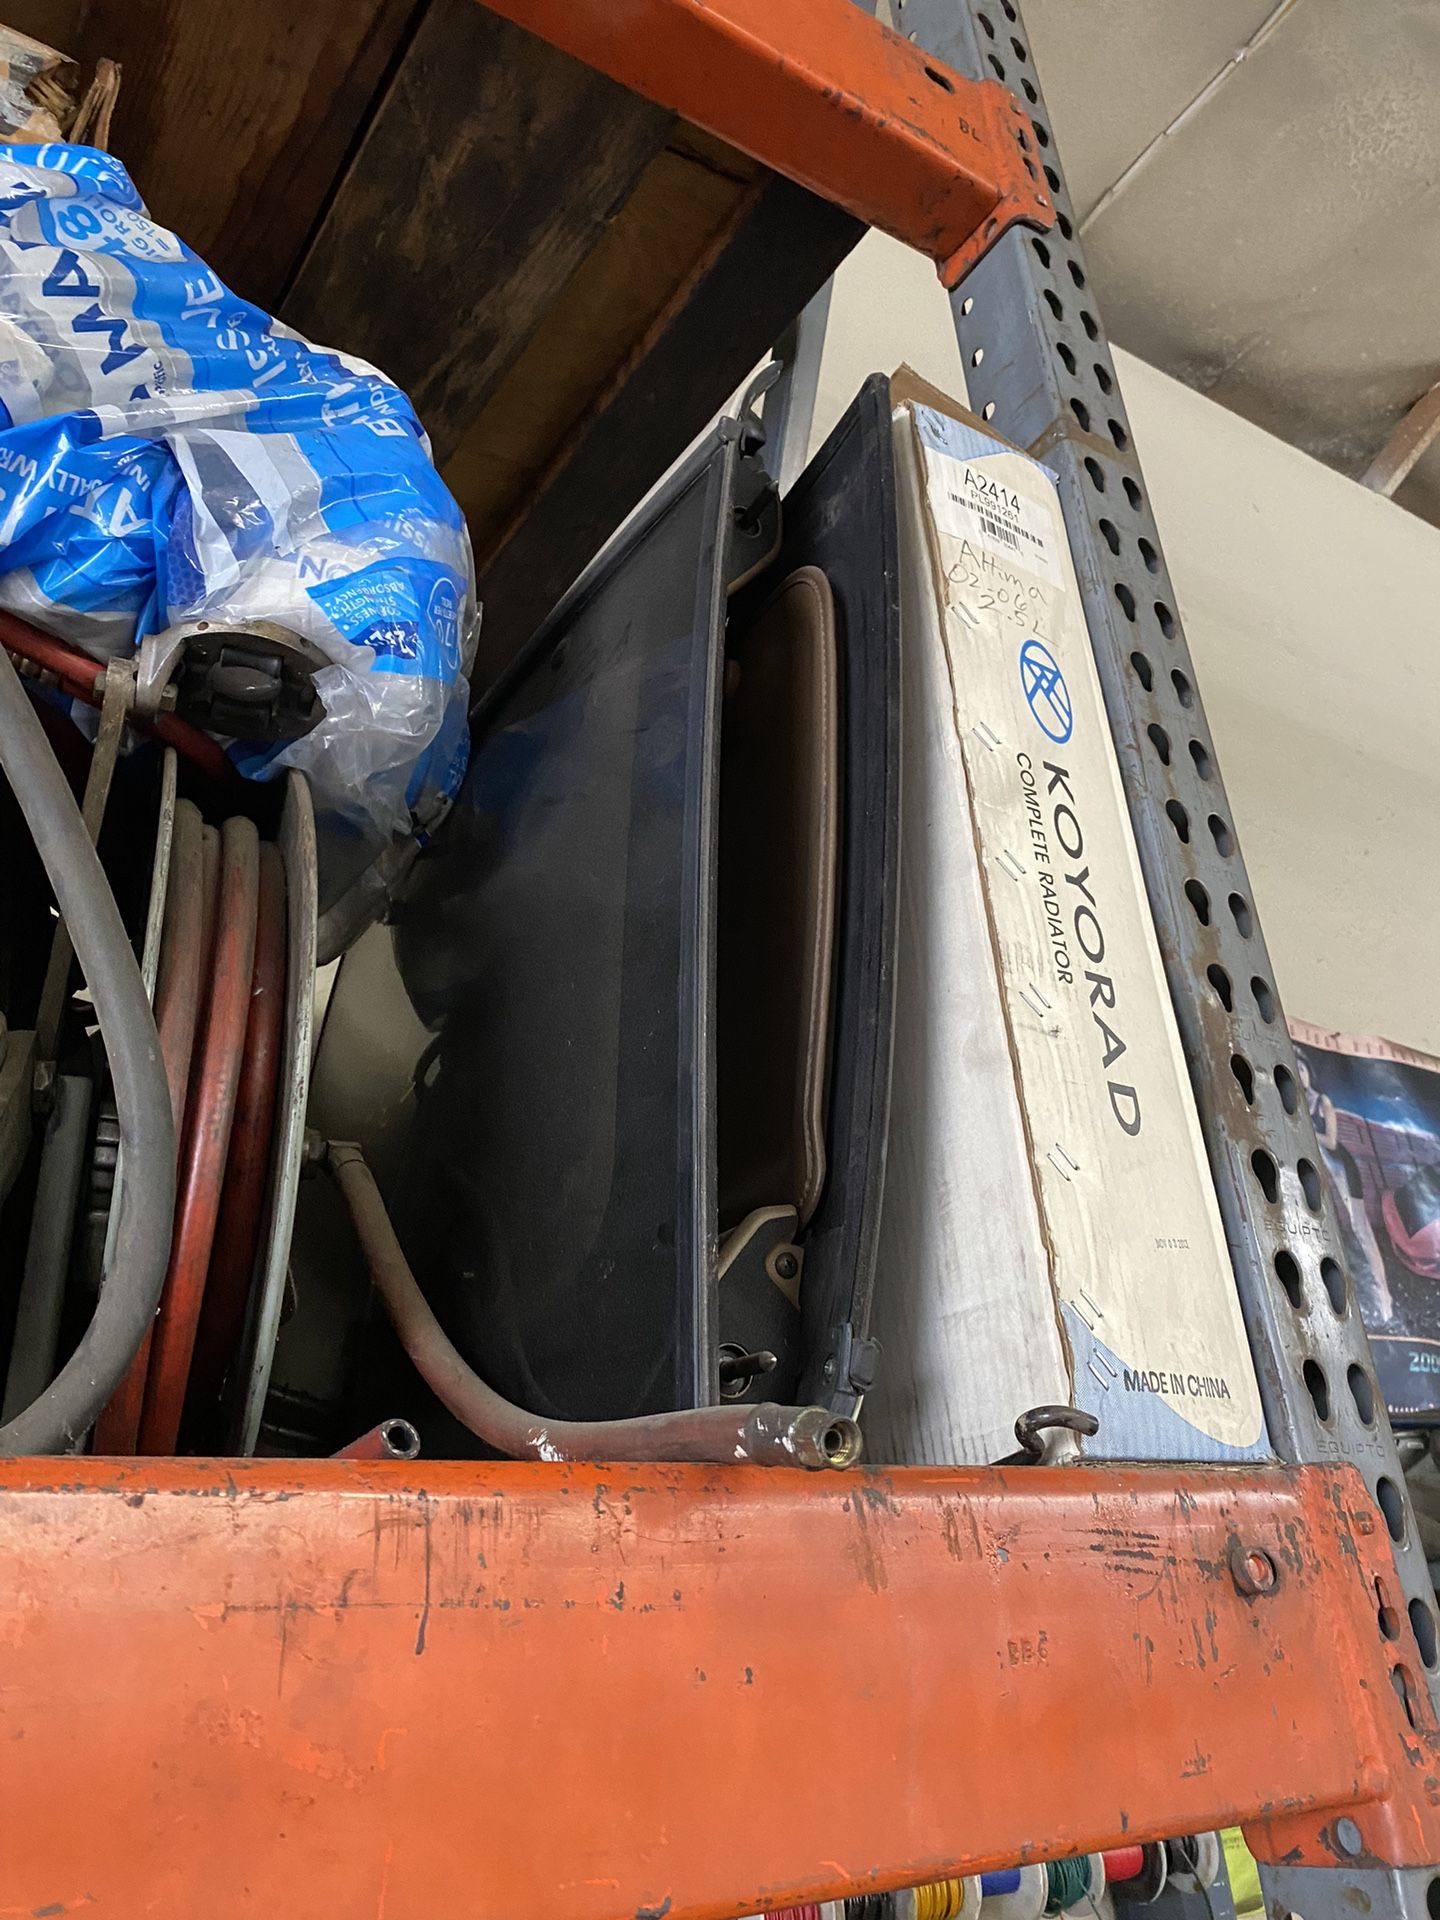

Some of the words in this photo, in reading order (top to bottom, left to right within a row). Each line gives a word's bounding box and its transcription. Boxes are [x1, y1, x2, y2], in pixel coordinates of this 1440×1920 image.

[964, 468, 1021, 514] A2414
[1016, 752, 1050, 865] COMPLETE
[1038, 869, 1074, 985] RADIATOR
[1042, 760, 1142, 1138] KOYORAD
[1123, 1369, 1169, 1394] MADE
[1170, 1373, 1186, 1395] IN
[1187, 1375, 1231, 1399] CHINA
[1317, 1440, 1386, 1458] EQUIPTO
